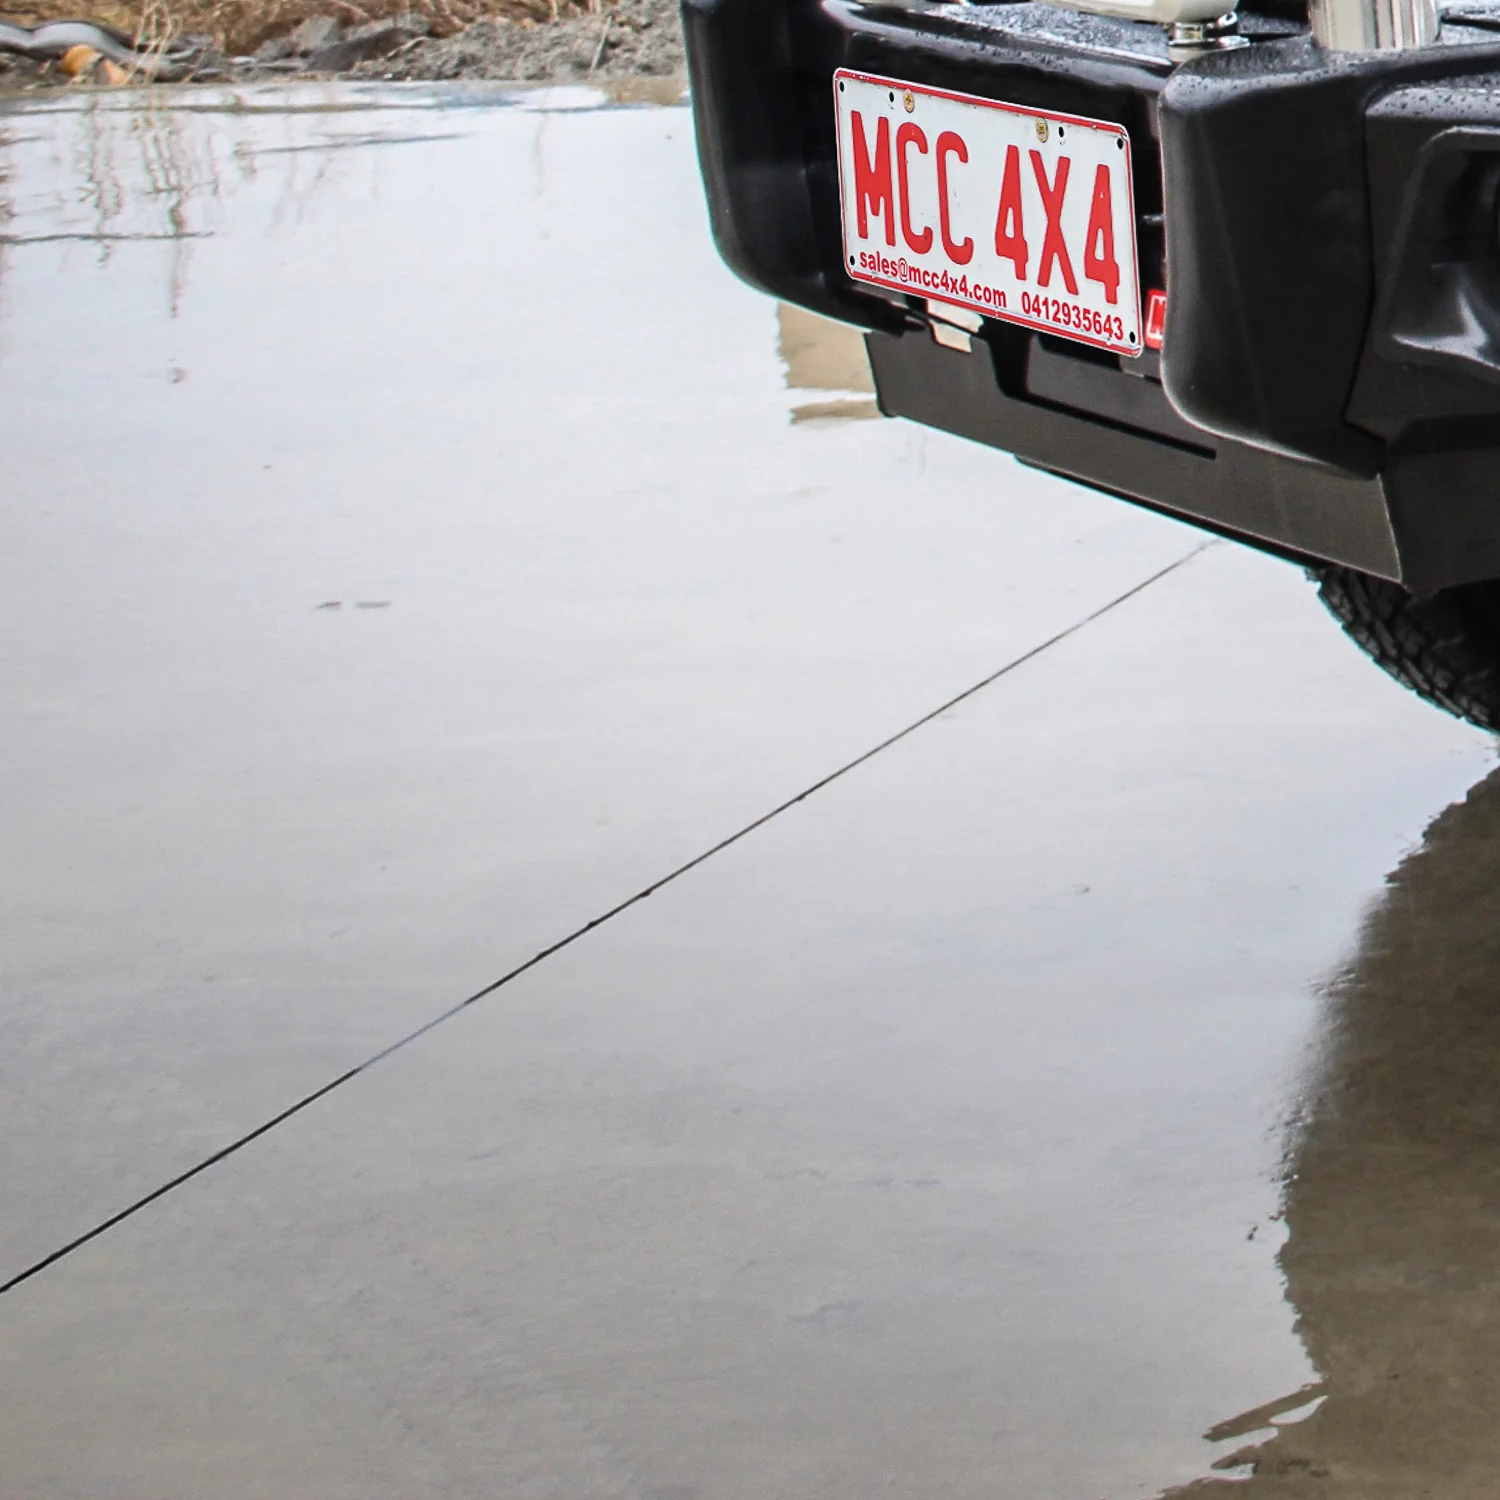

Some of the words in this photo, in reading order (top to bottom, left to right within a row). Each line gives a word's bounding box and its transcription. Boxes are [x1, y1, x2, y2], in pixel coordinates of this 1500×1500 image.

[851, 109, 974, 266] MCC
[995, 144, 1120, 305] 4X4
[859, 251, 1007, 309] sales@mcc4x4.com
[1021, 291, 1124, 341] 0412935643
